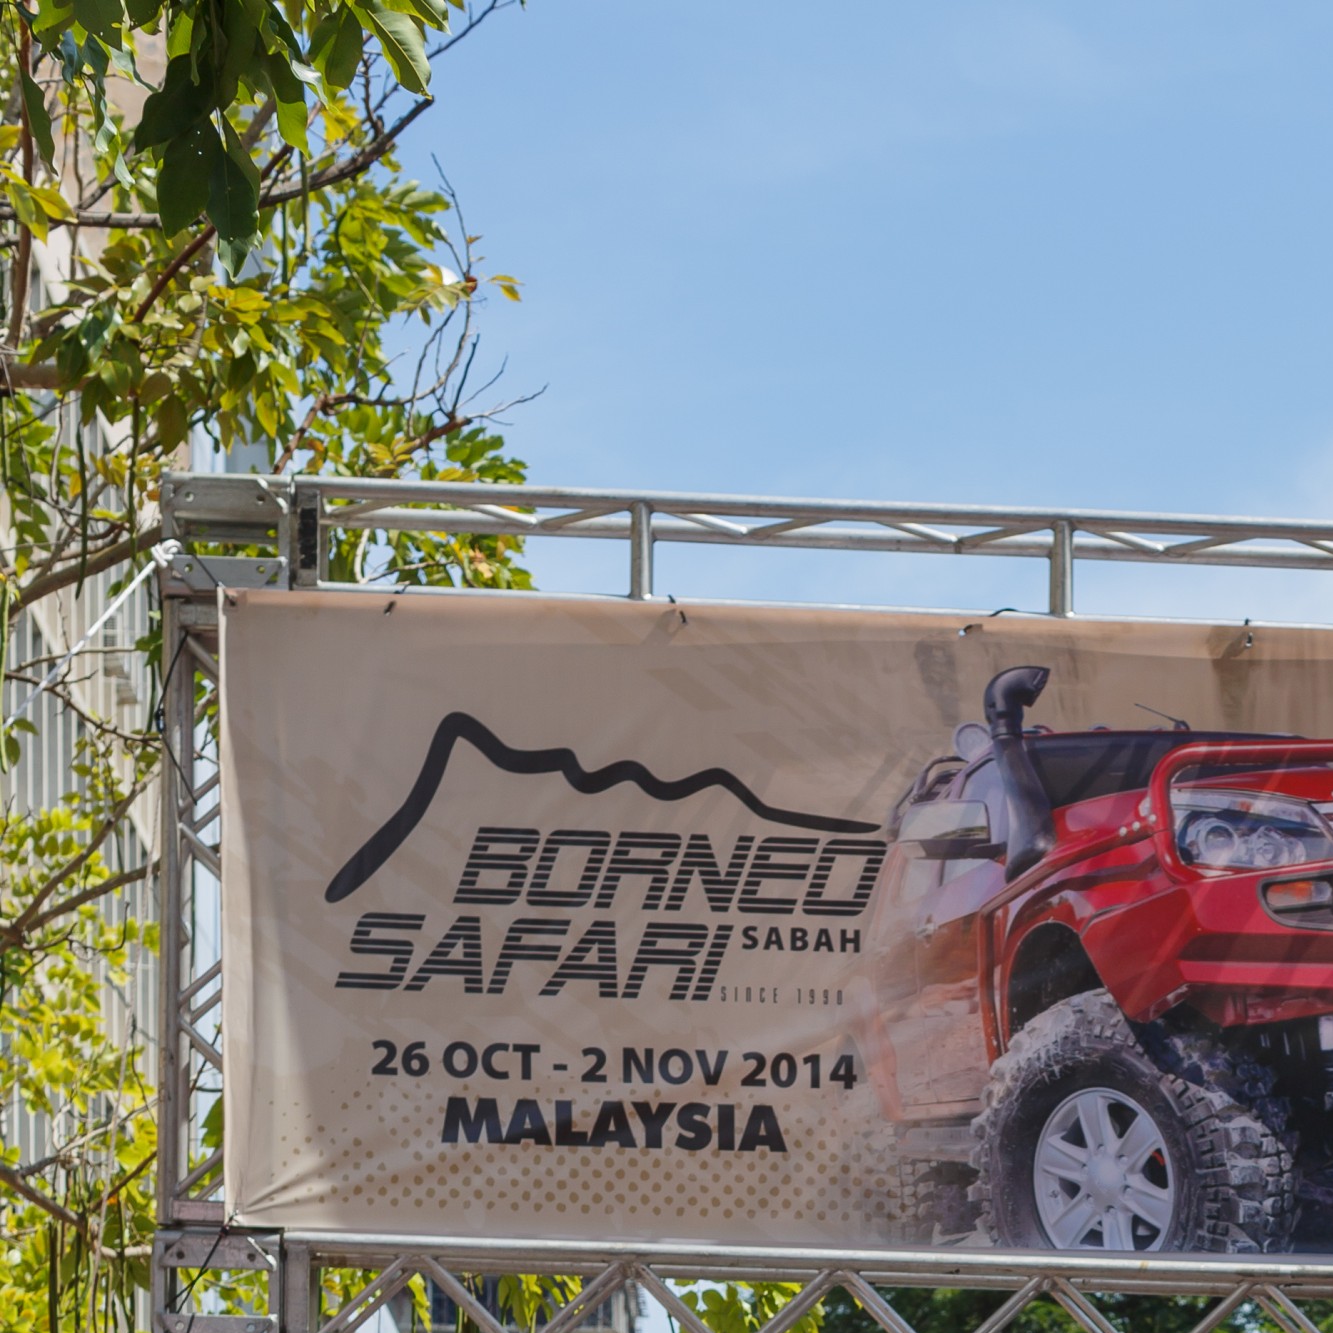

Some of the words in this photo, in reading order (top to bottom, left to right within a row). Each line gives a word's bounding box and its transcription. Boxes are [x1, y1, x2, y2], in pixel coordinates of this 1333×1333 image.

[452, 827, 888, 917] BORNEO
[334, 912, 734, 1001] SAFARI
[741, 925, 862, 955] SABAH
[720, 985, 778, 1004] SINCE
[797, 987, 843, 1006] 1990
[371, 1039, 430, 1078] 26
[442, 1041, 541, 1081] OCT
[580, 1046, 607, 1083] 2
[623, 1047, 728, 1087] NOV
[740, 1052, 858, 1091] 2014
[441, 1095, 788, 1153] MALAYSIA
